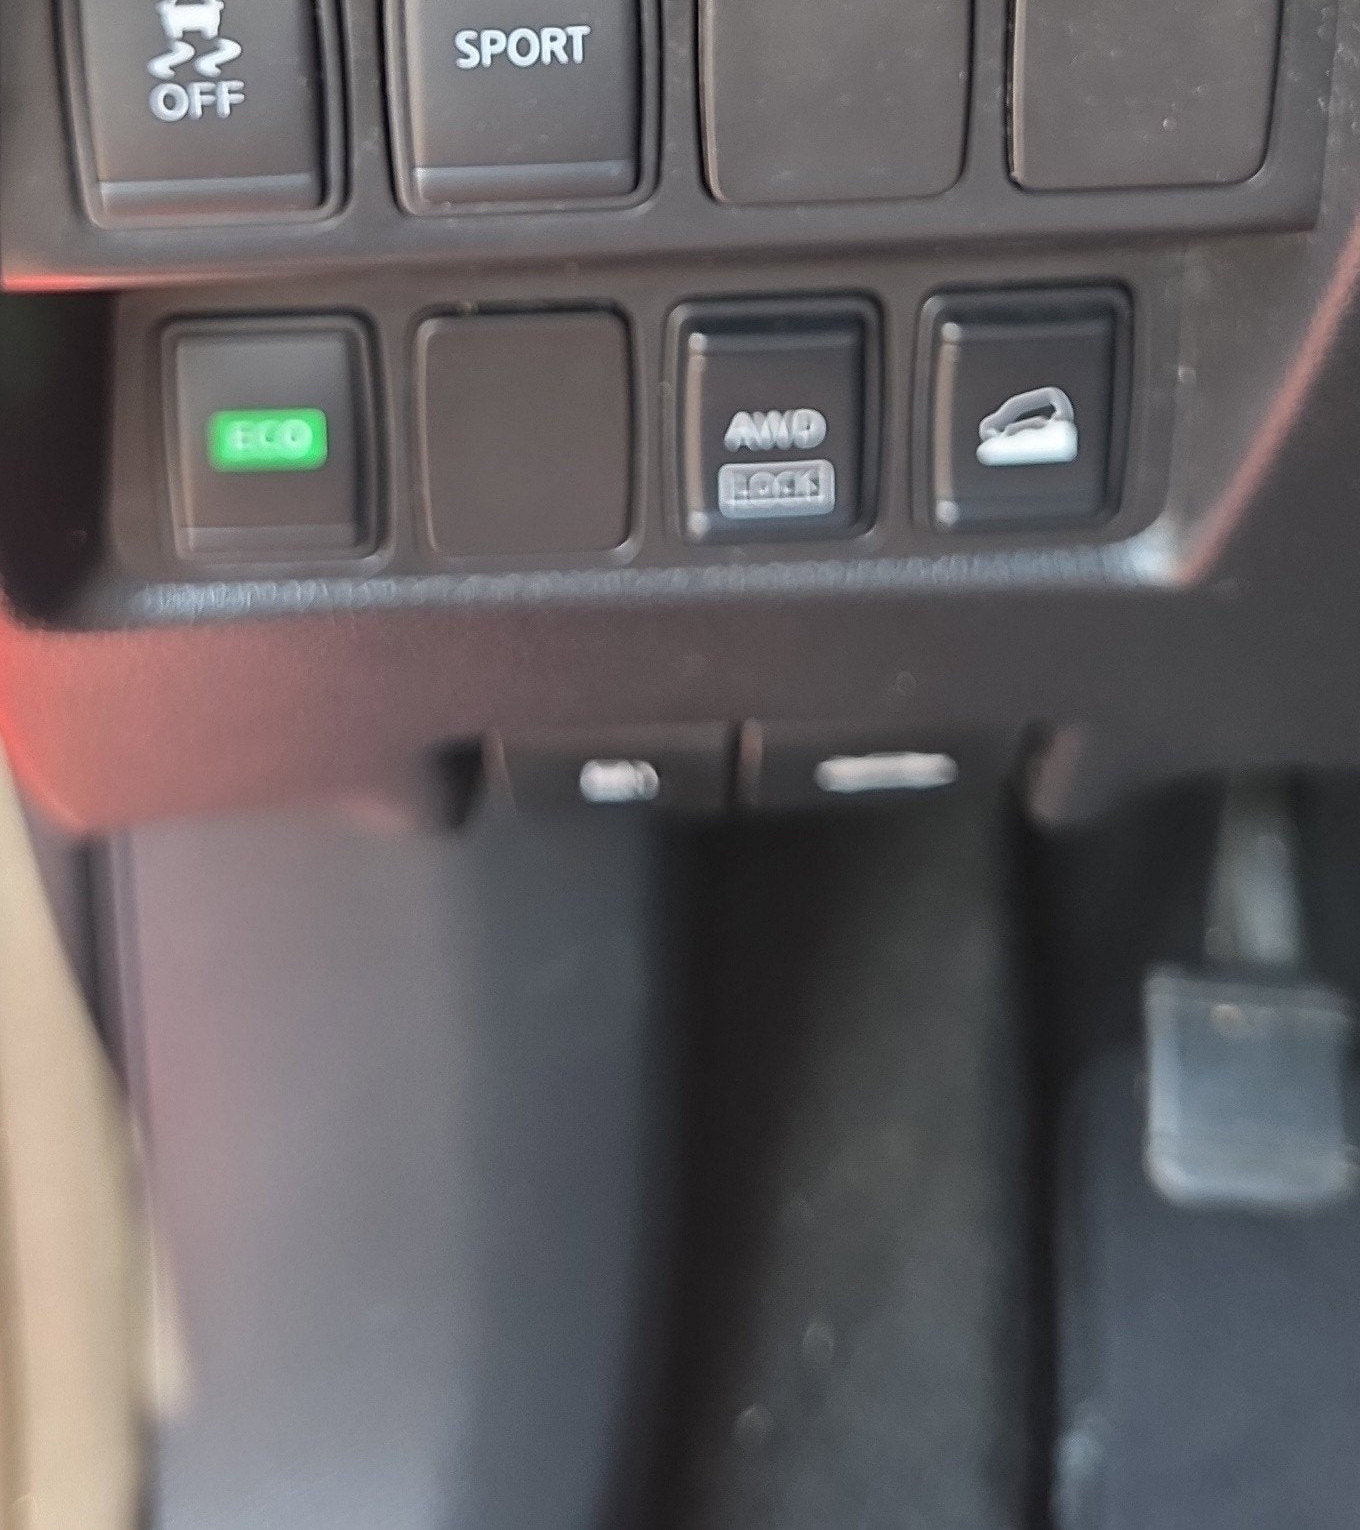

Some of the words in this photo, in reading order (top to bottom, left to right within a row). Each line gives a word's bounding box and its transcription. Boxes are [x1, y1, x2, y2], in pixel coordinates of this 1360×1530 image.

[454, 24, 592, 69] SPORT
[148, 79, 246, 123] OFF
[220, 416, 315, 463] ECO
[724, 408, 827, 452] AWD
